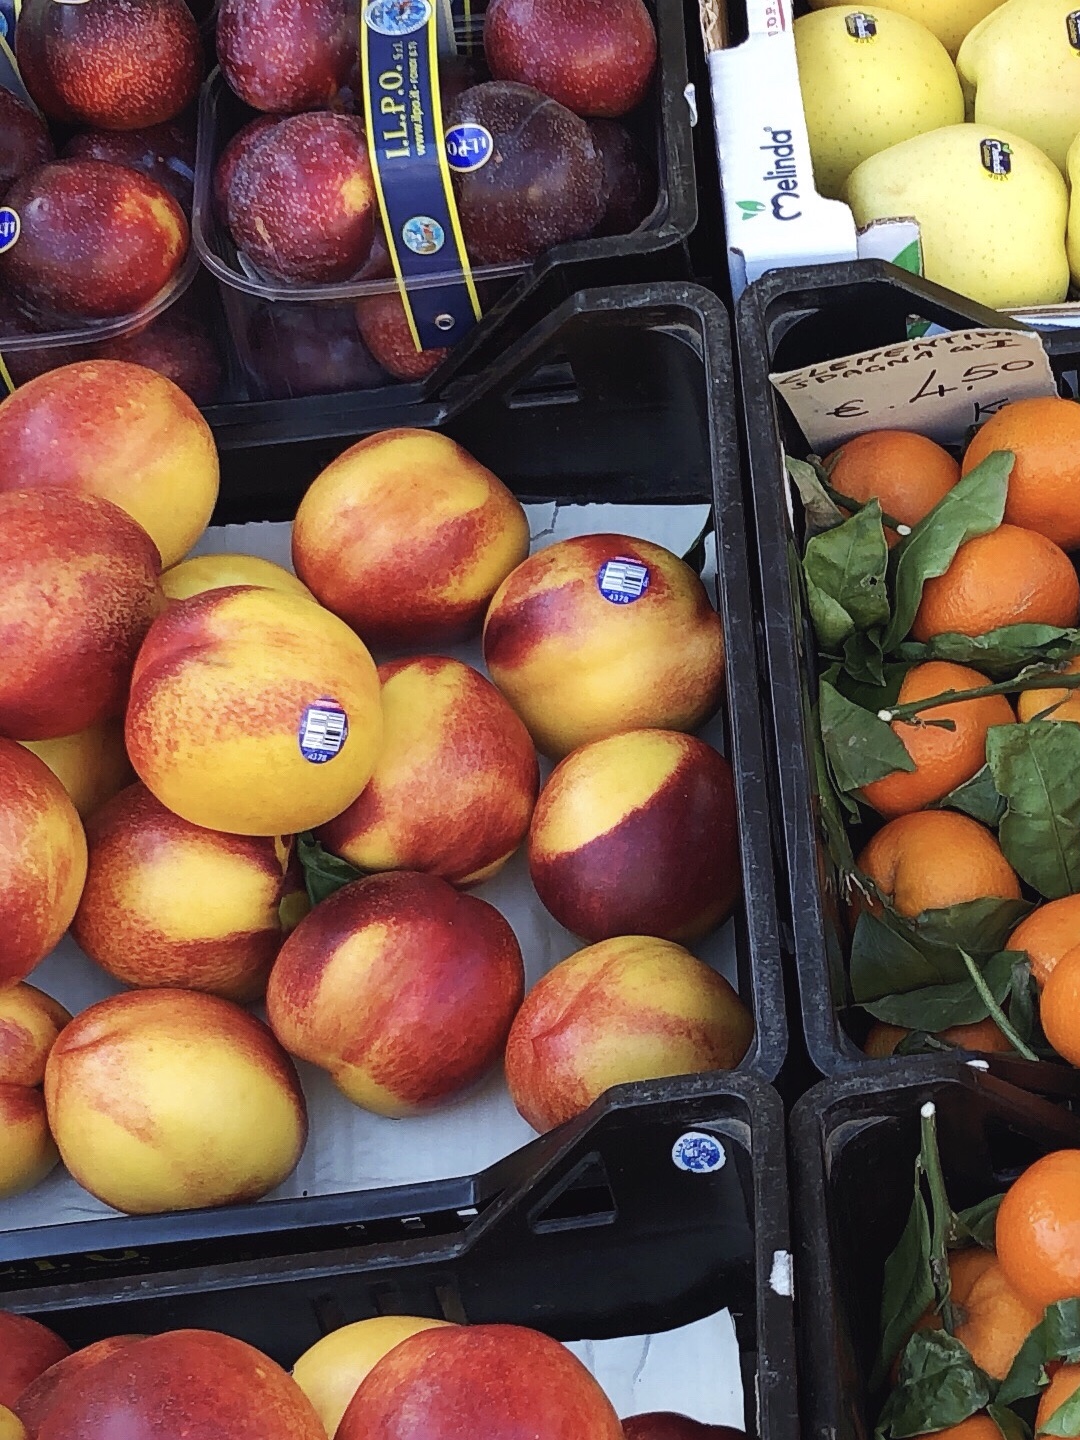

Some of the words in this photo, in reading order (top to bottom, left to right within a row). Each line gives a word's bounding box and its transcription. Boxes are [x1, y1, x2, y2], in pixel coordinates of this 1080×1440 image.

[378, 64, 411, 160] I.L.P.O.
[990, 141, 1005, 173] Melinda
[825, 399, 869, 418] €
[909, 359, 1035, 404] 4.50
